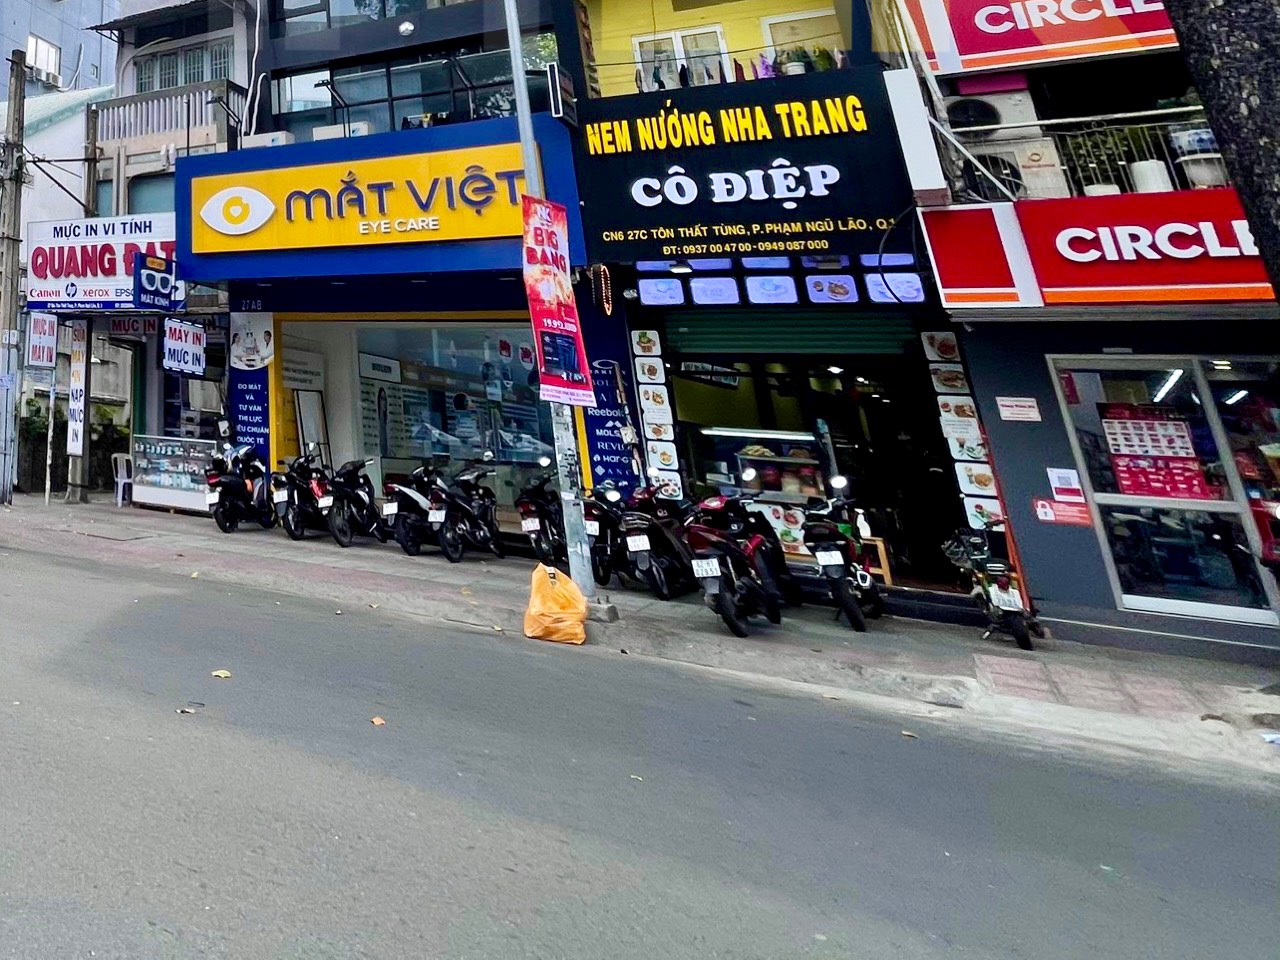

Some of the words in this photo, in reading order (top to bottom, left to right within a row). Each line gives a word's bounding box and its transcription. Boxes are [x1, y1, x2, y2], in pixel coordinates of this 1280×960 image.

[586, 121, 632, 155] NEM
[637, 99, 716, 151] NƯỚNG
[720, 105, 774, 143] NHA
[776, 94, 868, 139] TRANG
[631, 165, 698, 206] CÔ
[708, 157, 840, 209] ĐIỆP
[53, 223, 80, 240] MỰC
[85, 224, 98, 236] IN
[103, 222, 115, 235] VI
[121, 218, 152, 234] TÍNH
[358, 221, 391, 234] EYE
[394, 216, 439, 232] CARE
[602, 231, 624, 241] CN6
[627, 230, 648, 240] 27C
[650, 228, 674, 240] TÔN
[677, 225, 708, 238] THẤT
[712, 223, 750, 237] TÙNG,
[806, 218, 833, 232] NGŨ
[838, 218, 872, 231] LÃO,
[534, 227, 559, 250] BIG
[662, 246, 681, 256] ĐT:
[683, 244, 708, 254] 0937
[807, 240, 828, 249] 000
[31, 243, 117, 279] QUANG
[526, 246, 567, 274] BANG
[30, 288, 61, 298] Canon
[83, 288, 109, 297] xerox
[48, 320, 55, 336] IN
[144, 320, 156, 332] IN
[169, 325, 189, 343] MÁY
[192, 331, 202, 346] IN
[47, 346, 54, 362] IN
[167, 347, 189, 366] MỰC
[192, 352, 201, 367] IN
[72, 429, 79, 443] IN
